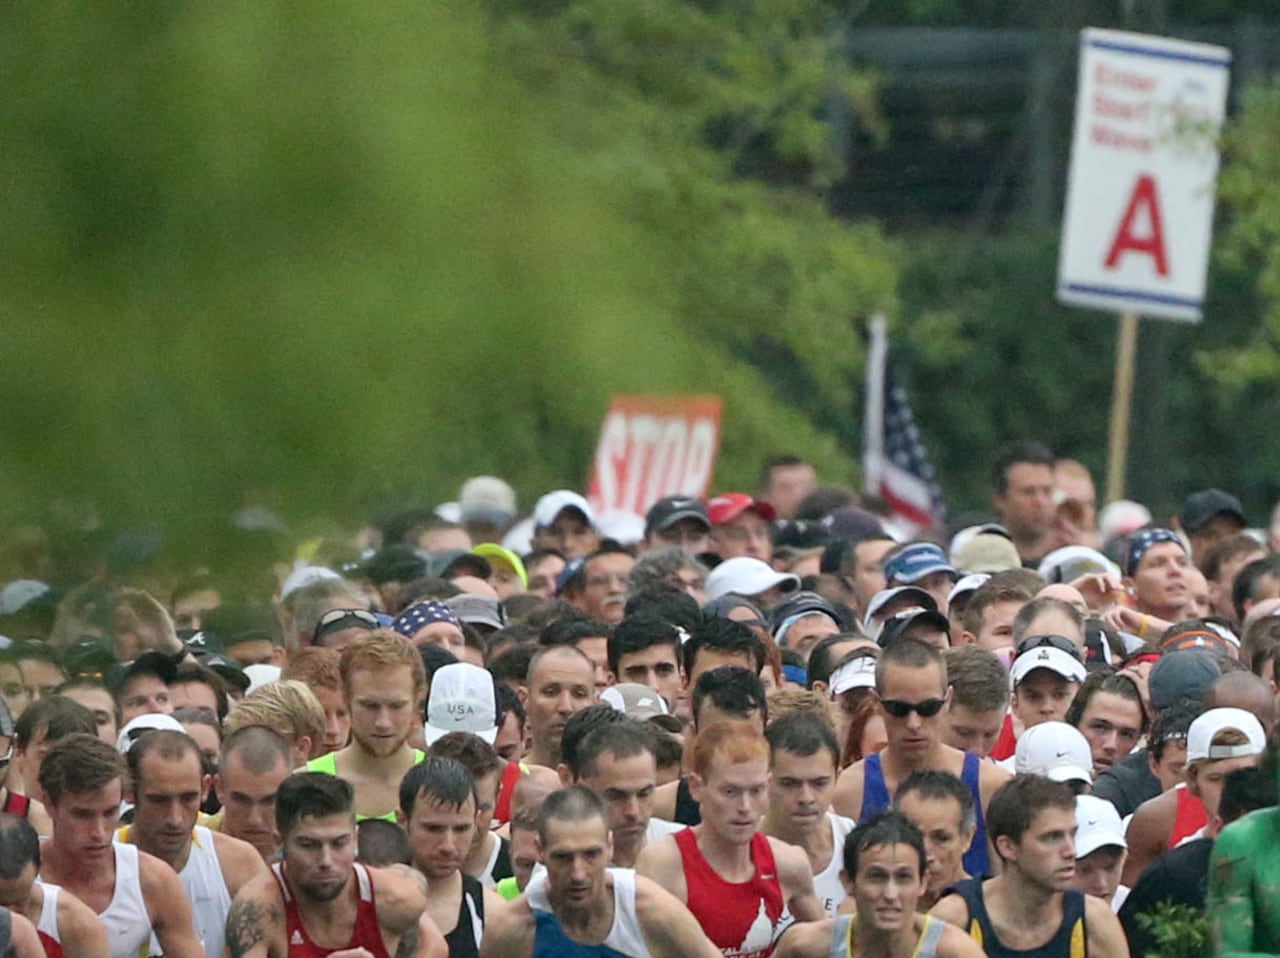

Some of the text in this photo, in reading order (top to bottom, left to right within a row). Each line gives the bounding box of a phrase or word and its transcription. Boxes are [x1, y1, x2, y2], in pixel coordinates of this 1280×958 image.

[1104, 173, 1171, 278] A
[592, 411, 716, 508] STOP
[447, 703, 475, 715] USA
